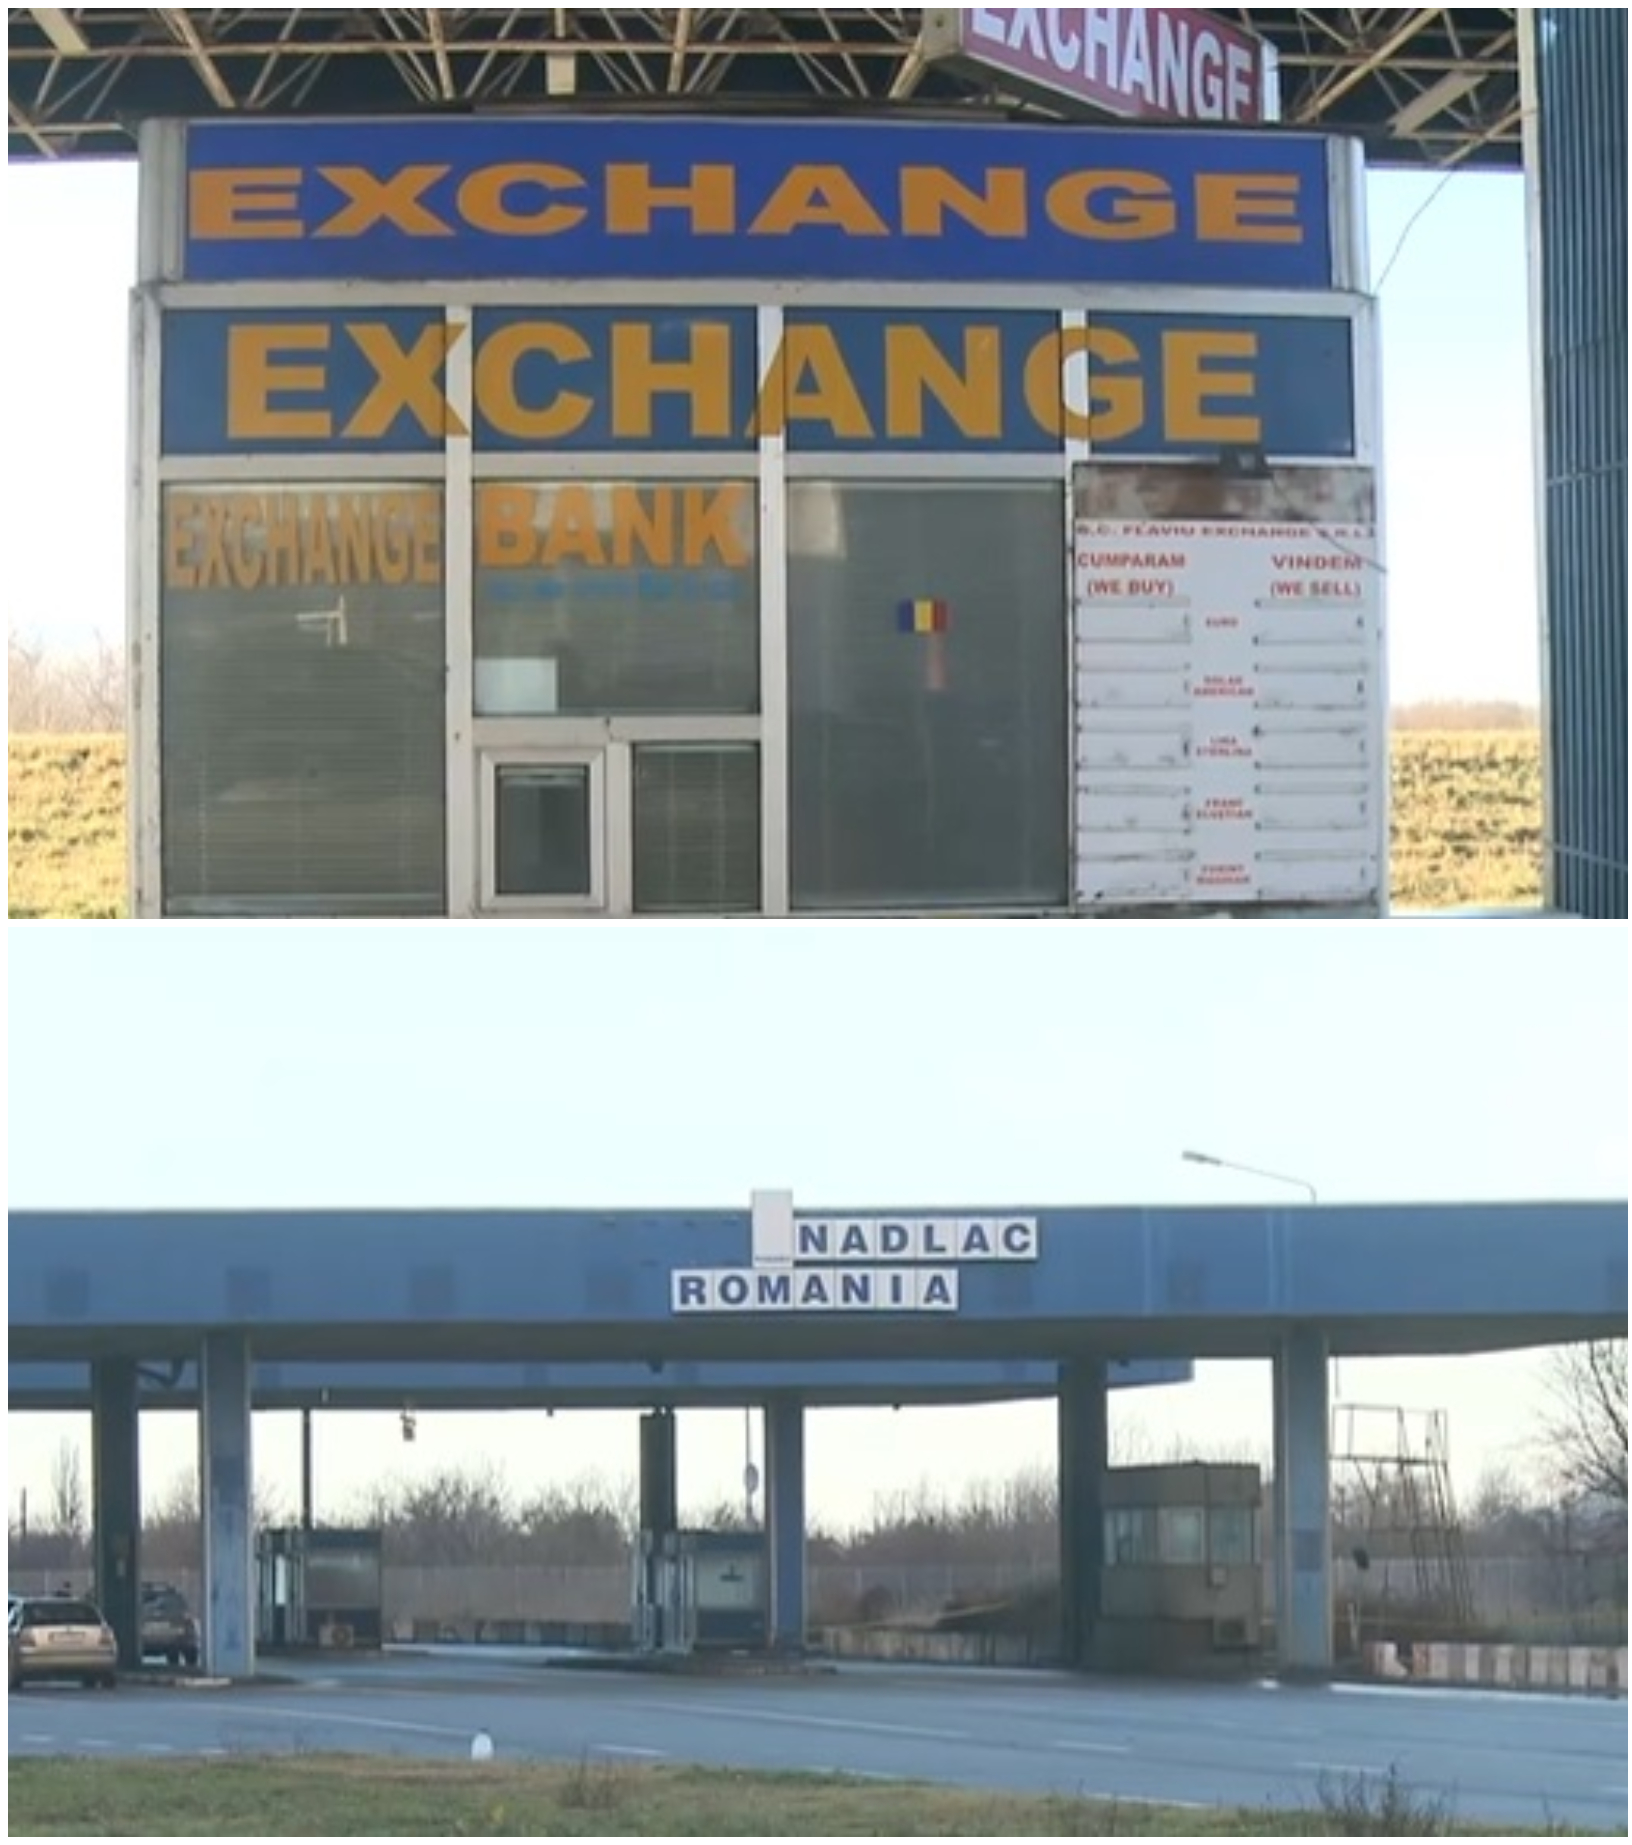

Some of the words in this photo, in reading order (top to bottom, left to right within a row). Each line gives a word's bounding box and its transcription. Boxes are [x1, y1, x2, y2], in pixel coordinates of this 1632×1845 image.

[189, 162, 1303, 243] EXCHANGE
[226, 321, 1262, 442] EXCHANGE
[169, 488, 440, 590] EXCHANGE
[480, 482, 750, 568] BANK
[1077, 553, 1187, 569] CUMPARAM
[1271, 555, 1363, 570] VINDEM
[1087, 578, 1121, 596] (WE
[1128, 579, 1176, 597] BUY)
[1270, 581, 1305, 597] (WE
[1309, 582, 1362, 598] SELL)
[800, 1223, 1030, 1254] NADLAC
[679, 1275, 951, 1305] ROMANIA
